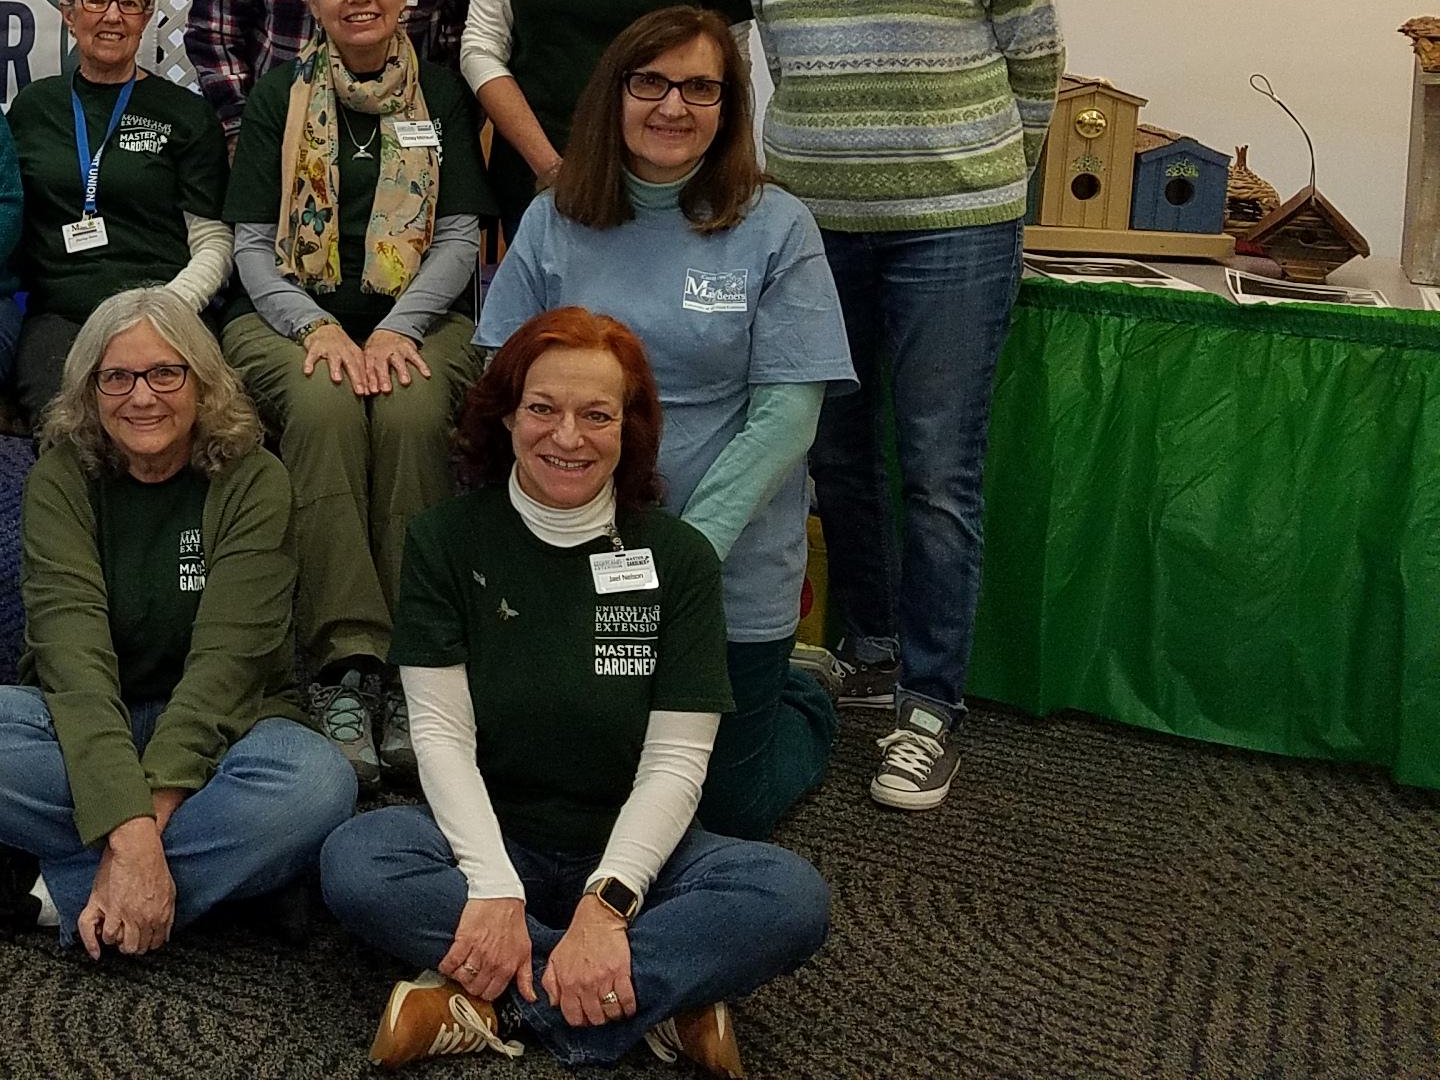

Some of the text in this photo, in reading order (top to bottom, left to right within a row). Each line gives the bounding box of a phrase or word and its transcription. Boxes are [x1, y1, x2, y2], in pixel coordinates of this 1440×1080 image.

[120, 131, 158, 141] MASTER
[85, 168, 99, 202] UNION
[595, 623, 658, 632] EXTENSIO
[594, 644, 652, 657] MASTER
